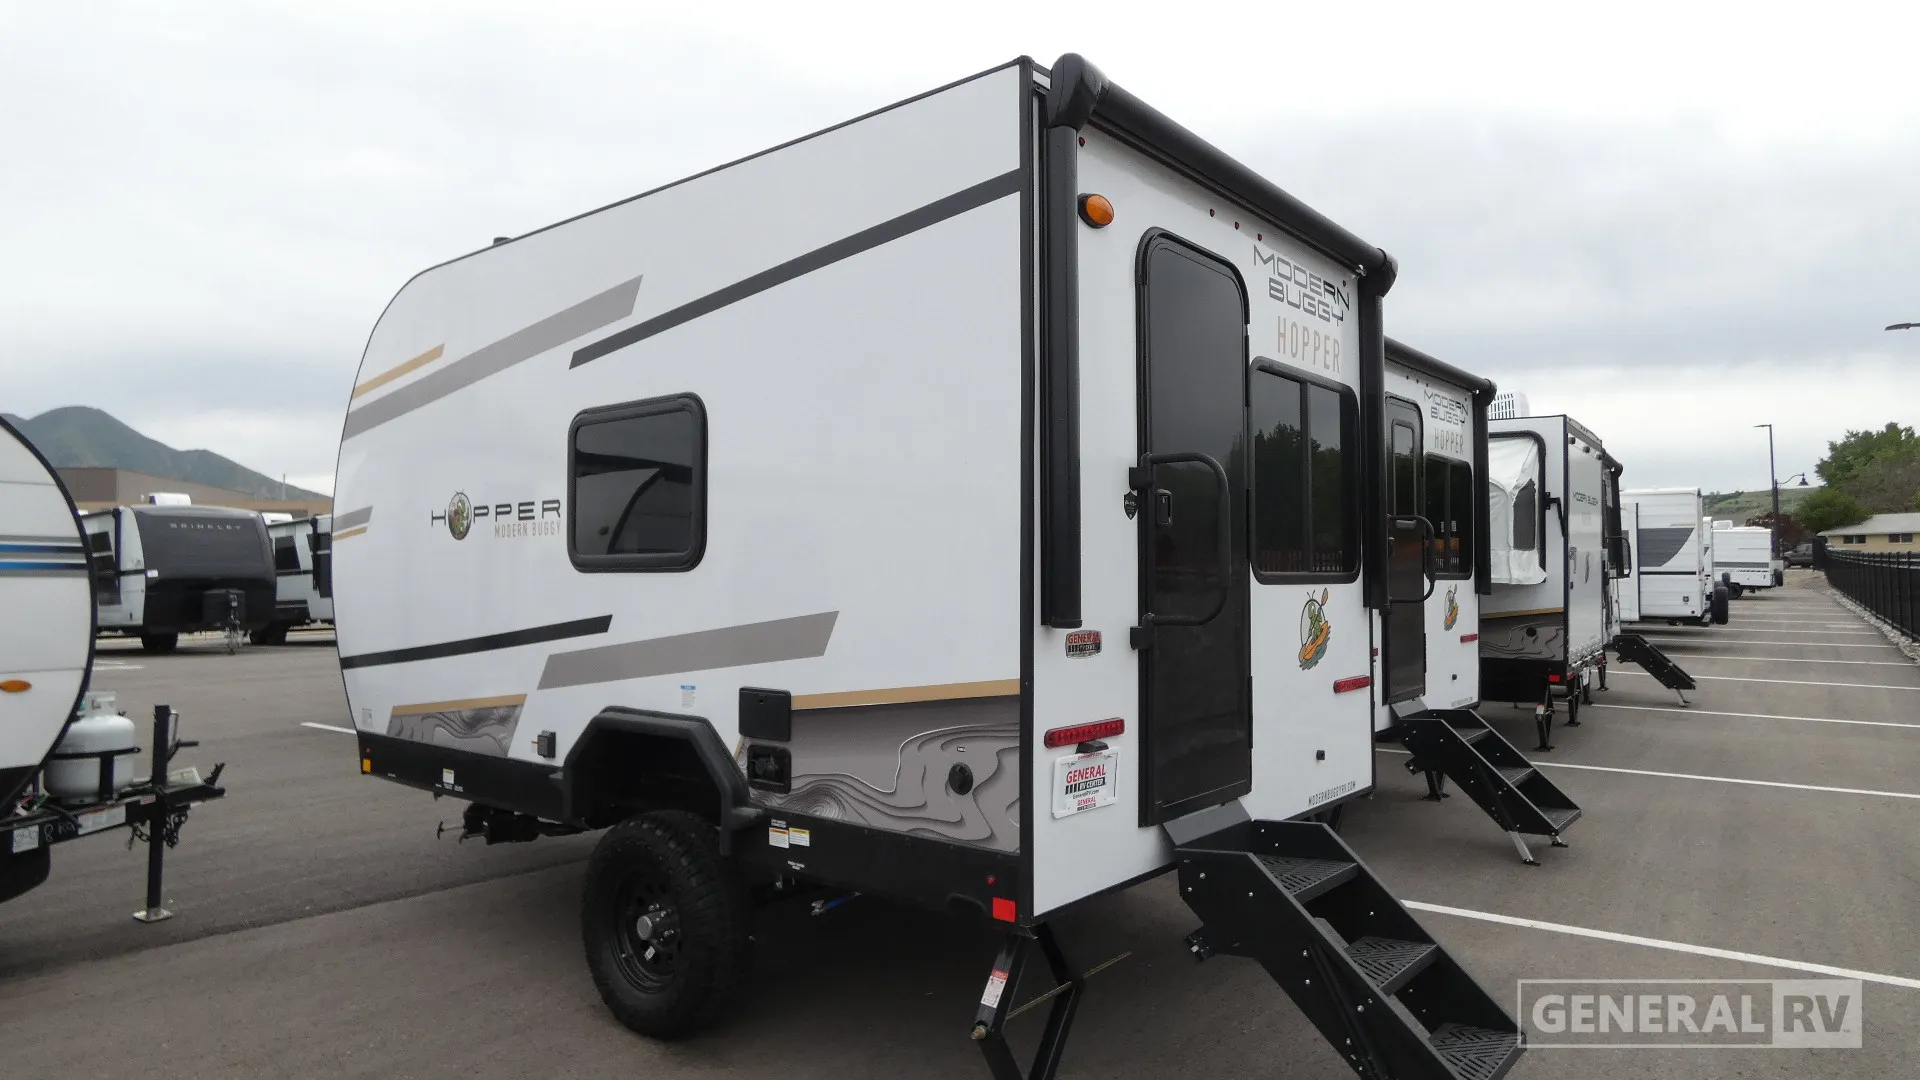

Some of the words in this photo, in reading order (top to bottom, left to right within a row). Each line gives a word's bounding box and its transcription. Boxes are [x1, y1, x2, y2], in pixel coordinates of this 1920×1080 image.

[1253, 244, 1350, 311] MODERN
[1268, 277, 1344, 327] BUGGY
[1277, 315, 1340, 374] HOPPER
[1434, 427, 1464, 455] HOPPER
[169, 522, 241, 530] BRINKLEY
[494, 522, 528, 538] MODERN
[532, 520, 561, 536] BUGGY
[1065, 763, 1106, 784] GENERAL
